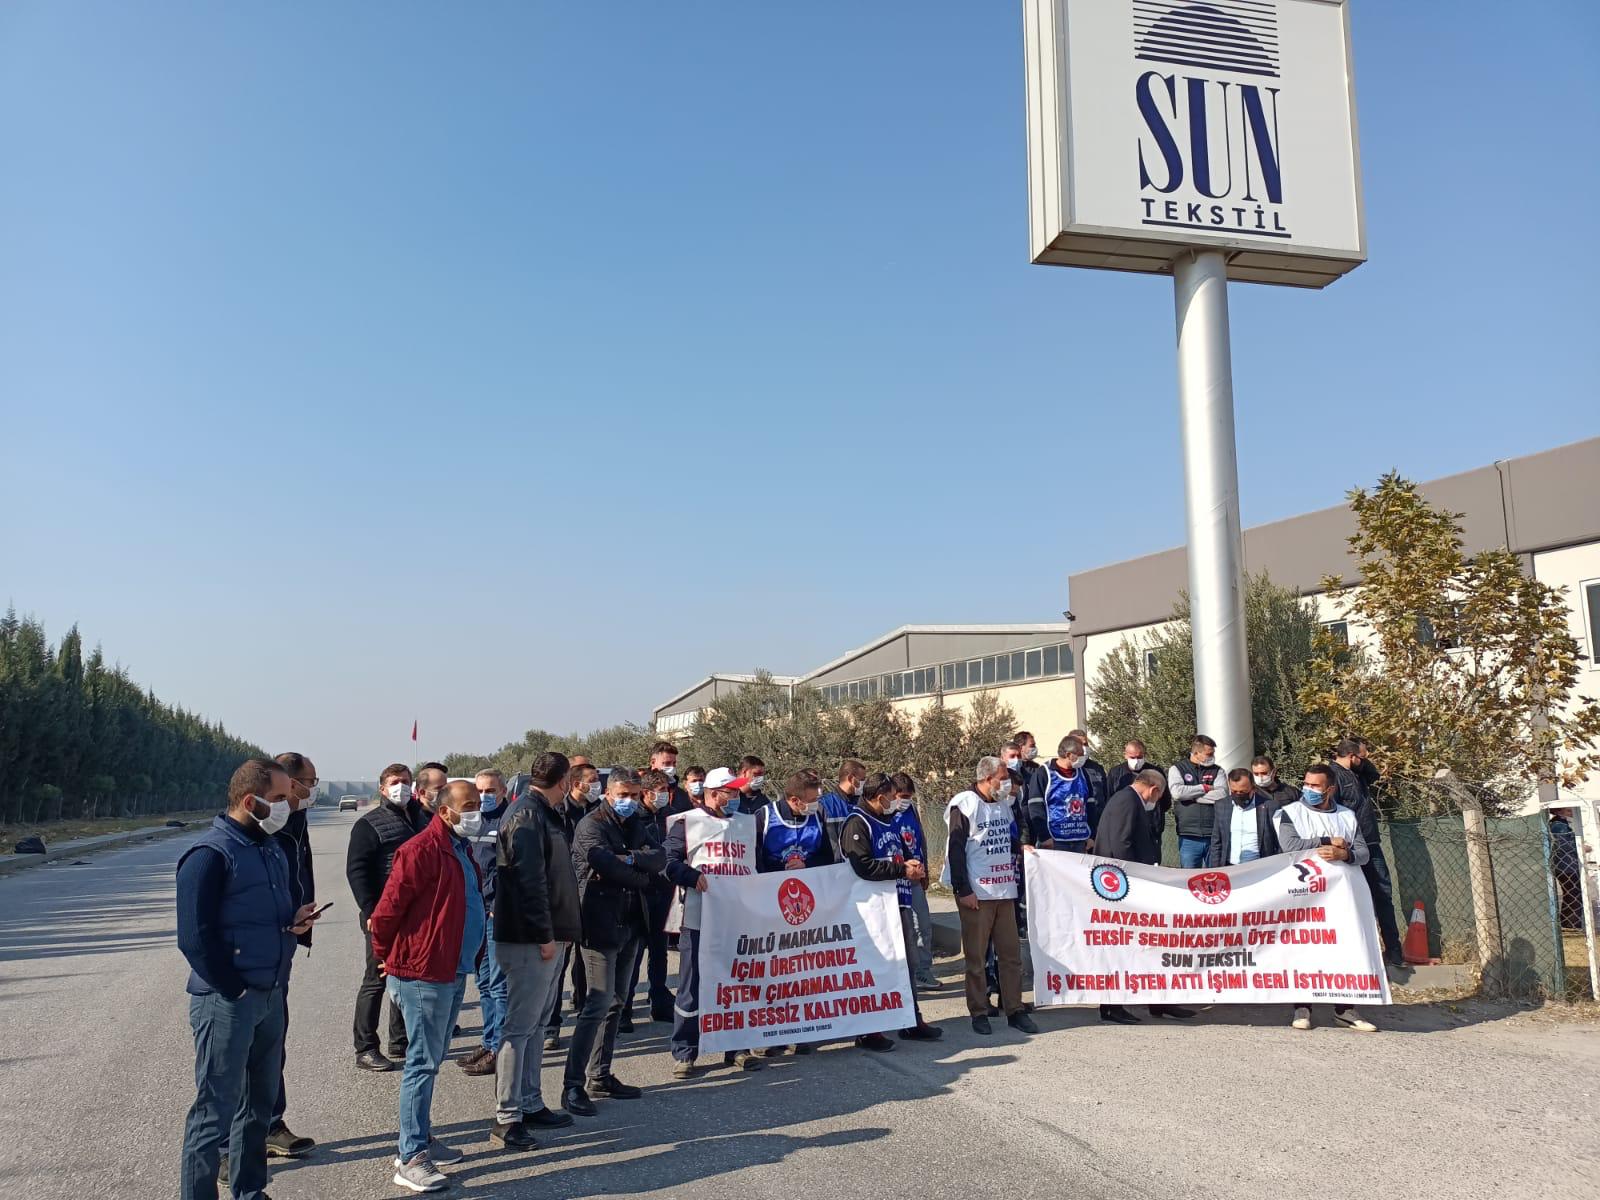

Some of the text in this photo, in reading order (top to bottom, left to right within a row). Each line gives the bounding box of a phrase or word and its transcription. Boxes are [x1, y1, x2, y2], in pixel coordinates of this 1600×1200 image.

[1136, 71, 1283, 204] SUN
[1141, 198, 1286, 231] TEKSTİL
[705, 840, 745, 859] TEKSİF
[1091, 907, 1326, 928] ANAYASAL HAKKIMI KULLANDIM
[737, 924, 853, 955] ÜNLÜ MARKALAR
[1084, 927, 1337, 948] TEKSİF SENDİKASI'NA ÜYE OLDUM
[731, 947, 857, 982] İÇİN ÜRETİYORUZ
[1161, 948, 1256, 967] SUN TEKSTİL
[716, 970, 875, 1009] İŞTEN ÇIKARMALARA
[1047, 969, 1381, 994] İŞ VERENİ İŞTEN ATTI İŞİMİ GERİ İSTİYORUM
[701, 992, 903, 1033] EDEN SESSİZ KALIYORLAR
